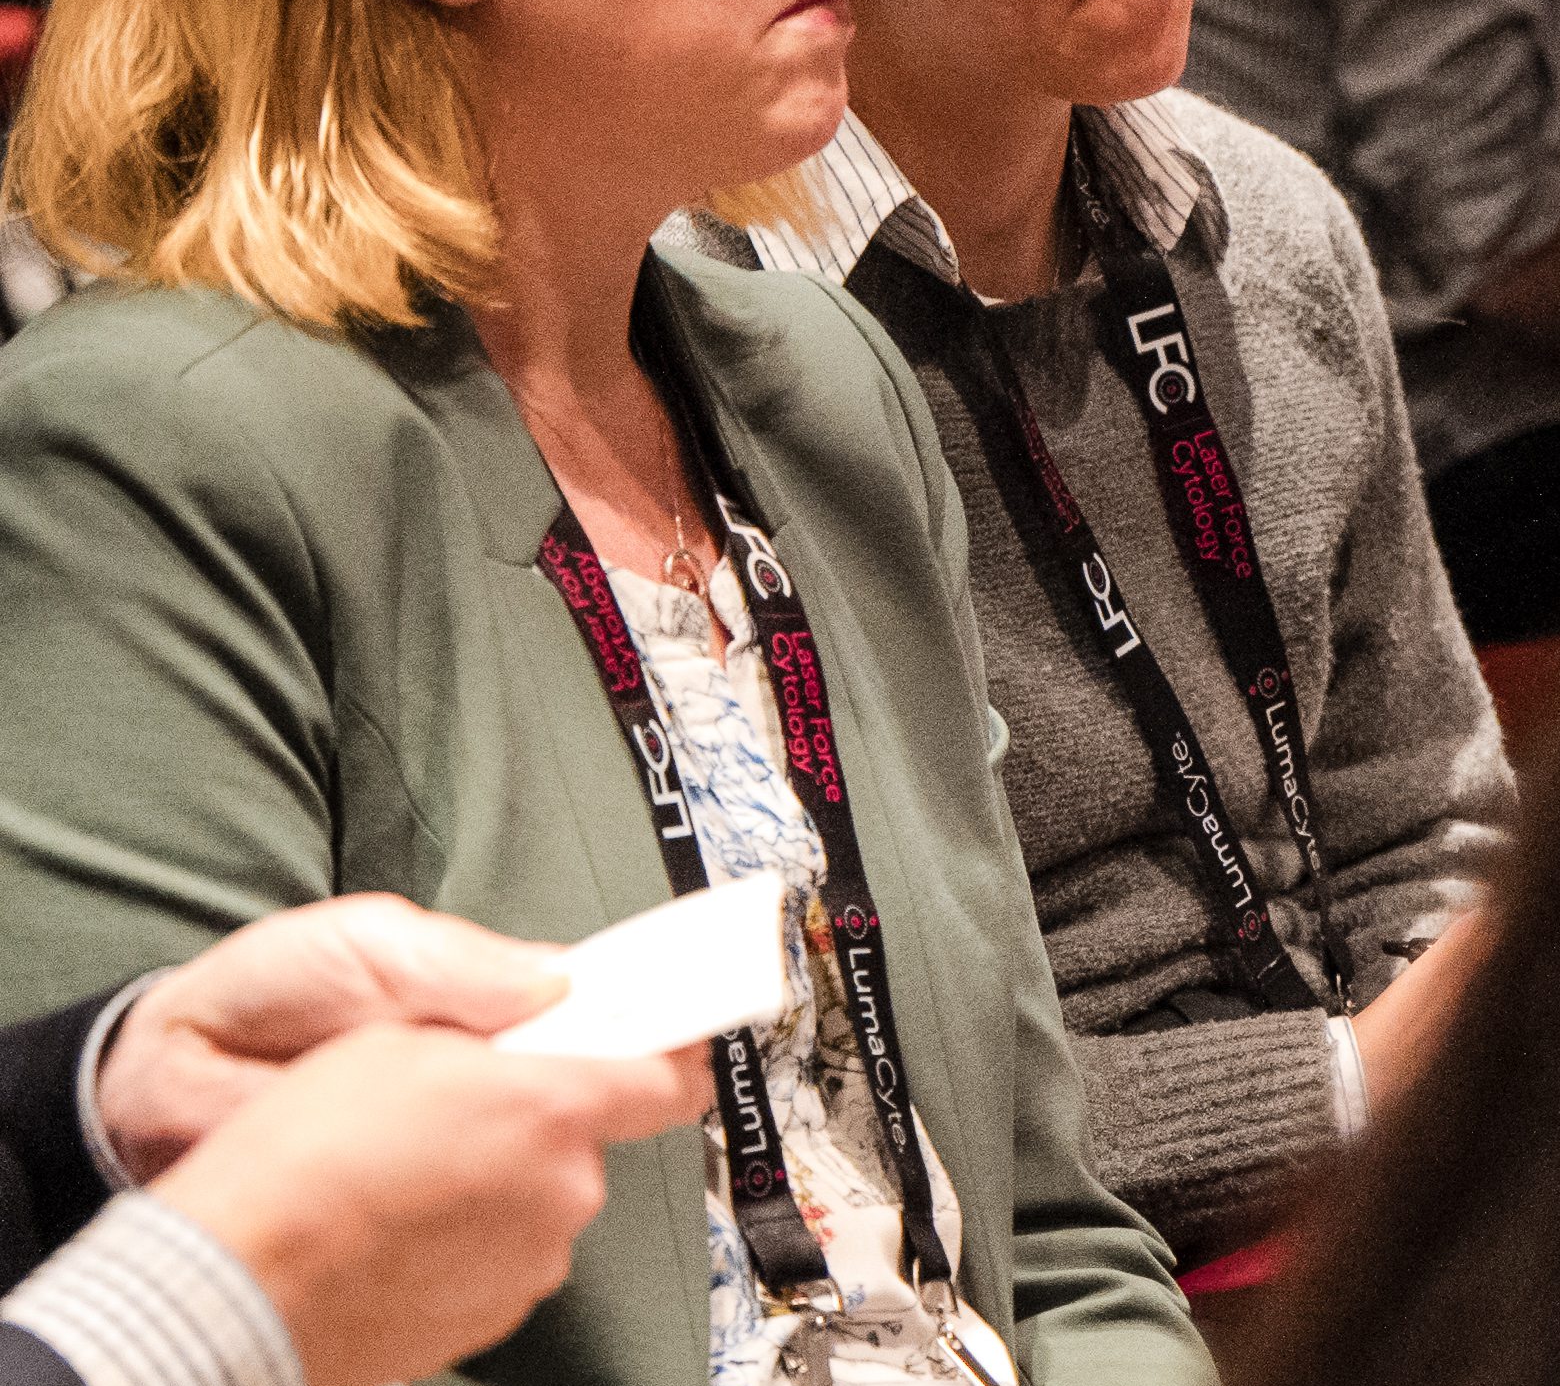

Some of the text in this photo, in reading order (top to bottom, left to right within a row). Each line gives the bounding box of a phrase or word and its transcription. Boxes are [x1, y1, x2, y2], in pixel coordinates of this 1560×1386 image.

[1127, 303, 1196, 414] LFC
[1171, 438, 1221, 562] Cytology
[1195, 429, 1252, 579] Laser Force
[1082, 552, 1142, 658] LFC
[792, 631, 842, 803] Laser Force
[632, 718, 694, 840] LFC
